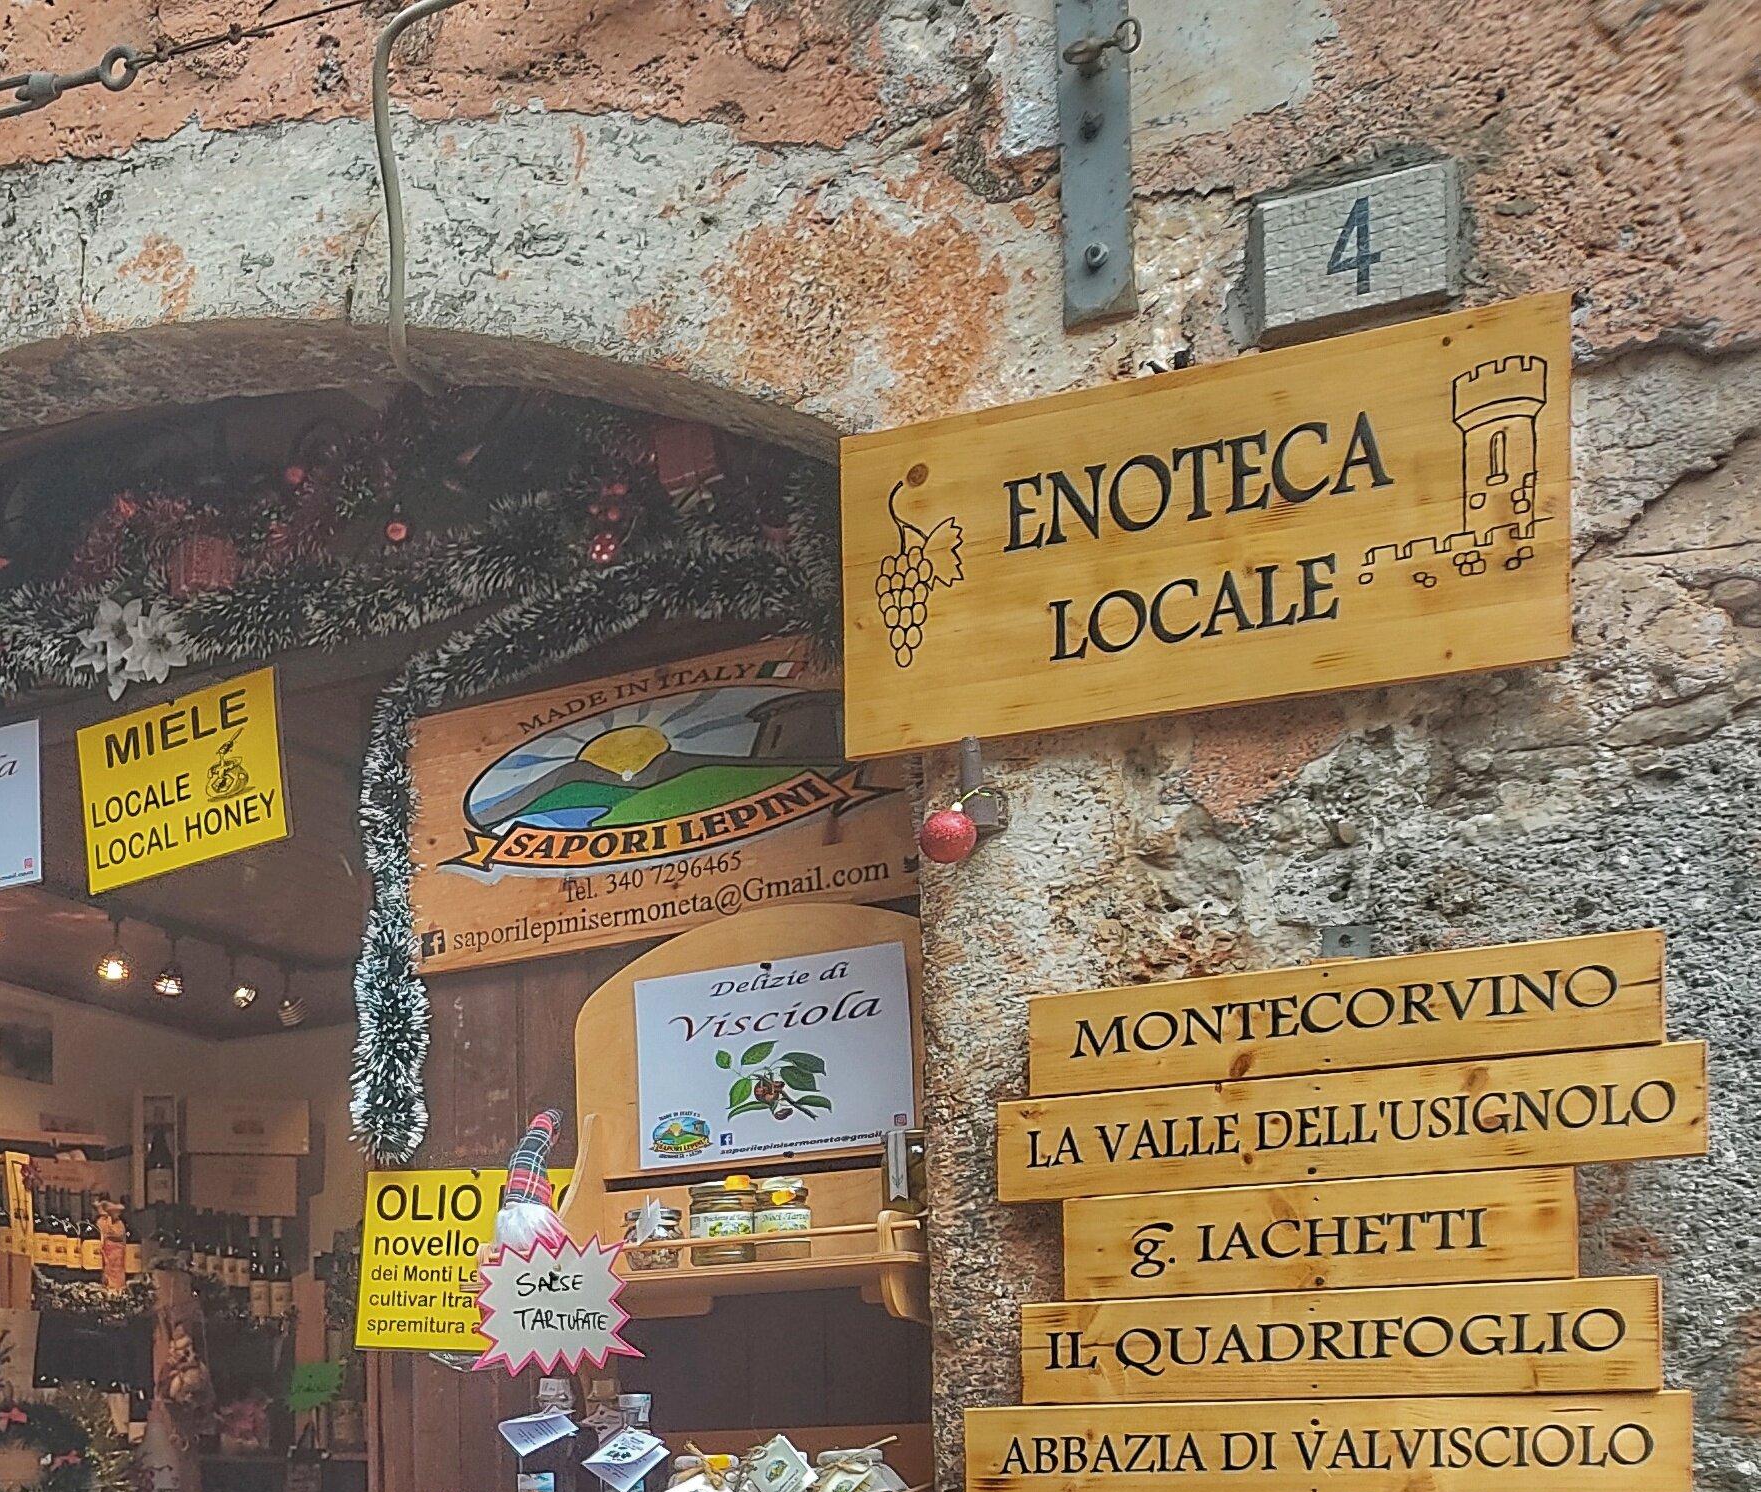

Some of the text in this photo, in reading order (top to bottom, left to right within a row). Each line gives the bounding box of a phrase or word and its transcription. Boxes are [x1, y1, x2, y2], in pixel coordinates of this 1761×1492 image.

[1326, 197, 1381, 295] 4
[1002, 411, 1394, 556] ENOTECA
[1048, 553, 1339, 663] LOCALE
[516, 661, 756, 735] MADE IN ITALY
[105, 688, 249, 769] MIELE
[91, 772, 191, 828] LOCALE
[504, 777, 830, 860] SAPORI LEPINI
[95, 788, 276, 870] LOCAL HONEY
[562, 850, 742, 904] Tel. 340 7296465
[452, 861, 889, 952] saporilepinisermoneta@Gmail.com
[710, 961, 849, 997] Delizie di
[669, 989, 882, 1042] Visciola
[1069, 964, 1619, 1058] MONTECORVINO
[1026, 1080, 1677, 1169] LA VALLE DELL'USIGNOLO
[376, 1184, 482, 1222] OLIO
[374, 1230, 479, 1257] novello
[1196, 1207, 1488, 1262] IACHETTI
[369, 1290, 437, 1307] cultivar
[371, 1266, 398, 1281] dei
[404, 1265, 453, 1282] Monti
[516, 1273, 583, 1296] SALSE
[367, 1315, 465, 1335] spremitura
[513, 1308, 609, 1331] TARTUFATE
[1044, 1308, 1626, 1377] IL QUADRIFOGLIO
[1000, 1422, 1653, 1474] ABBAZIA DI VALVISCIOLO
